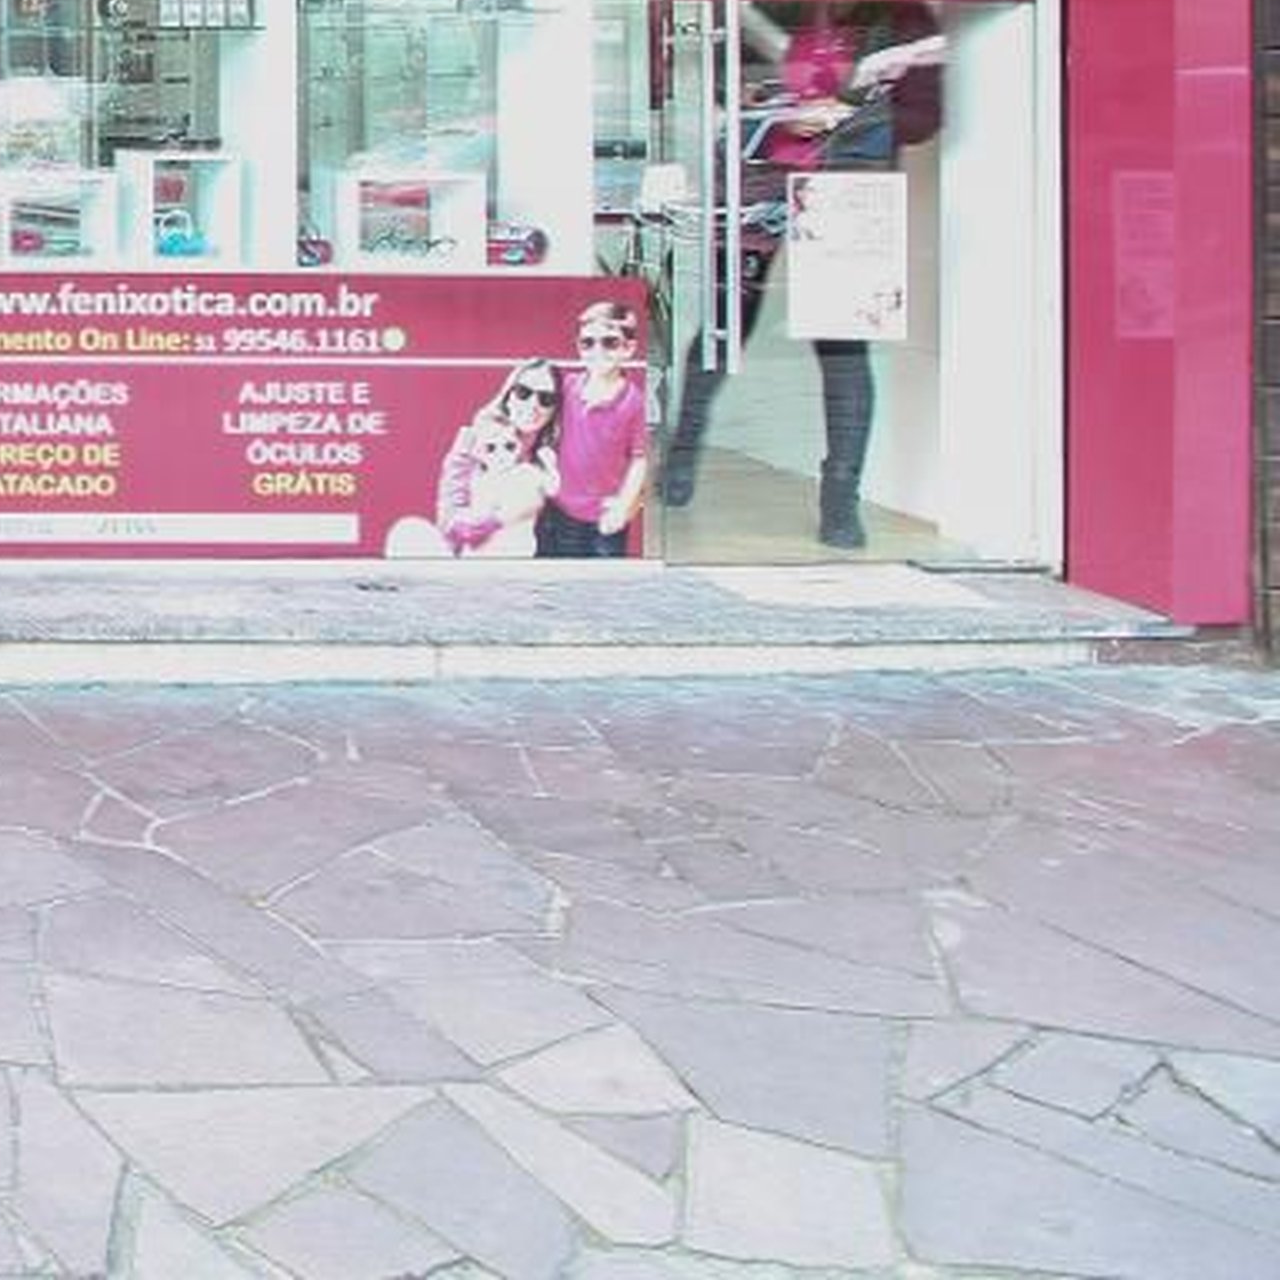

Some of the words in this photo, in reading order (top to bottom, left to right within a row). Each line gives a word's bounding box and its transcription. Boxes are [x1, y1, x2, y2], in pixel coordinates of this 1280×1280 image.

[79, 327, 121, 352] On
[124, 327, 190, 352] Line:
[238, 382, 347, 406] AJUSTE
[352, 382, 370, 405] E
[223, 412, 342, 436] LIMPEZA
[347, 413, 388, 435] DE
[83, 444, 121, 466] DE
[246, 439, 363, 466] ÓCULOS
[253, 469, 356, 497] GRÁTIS
